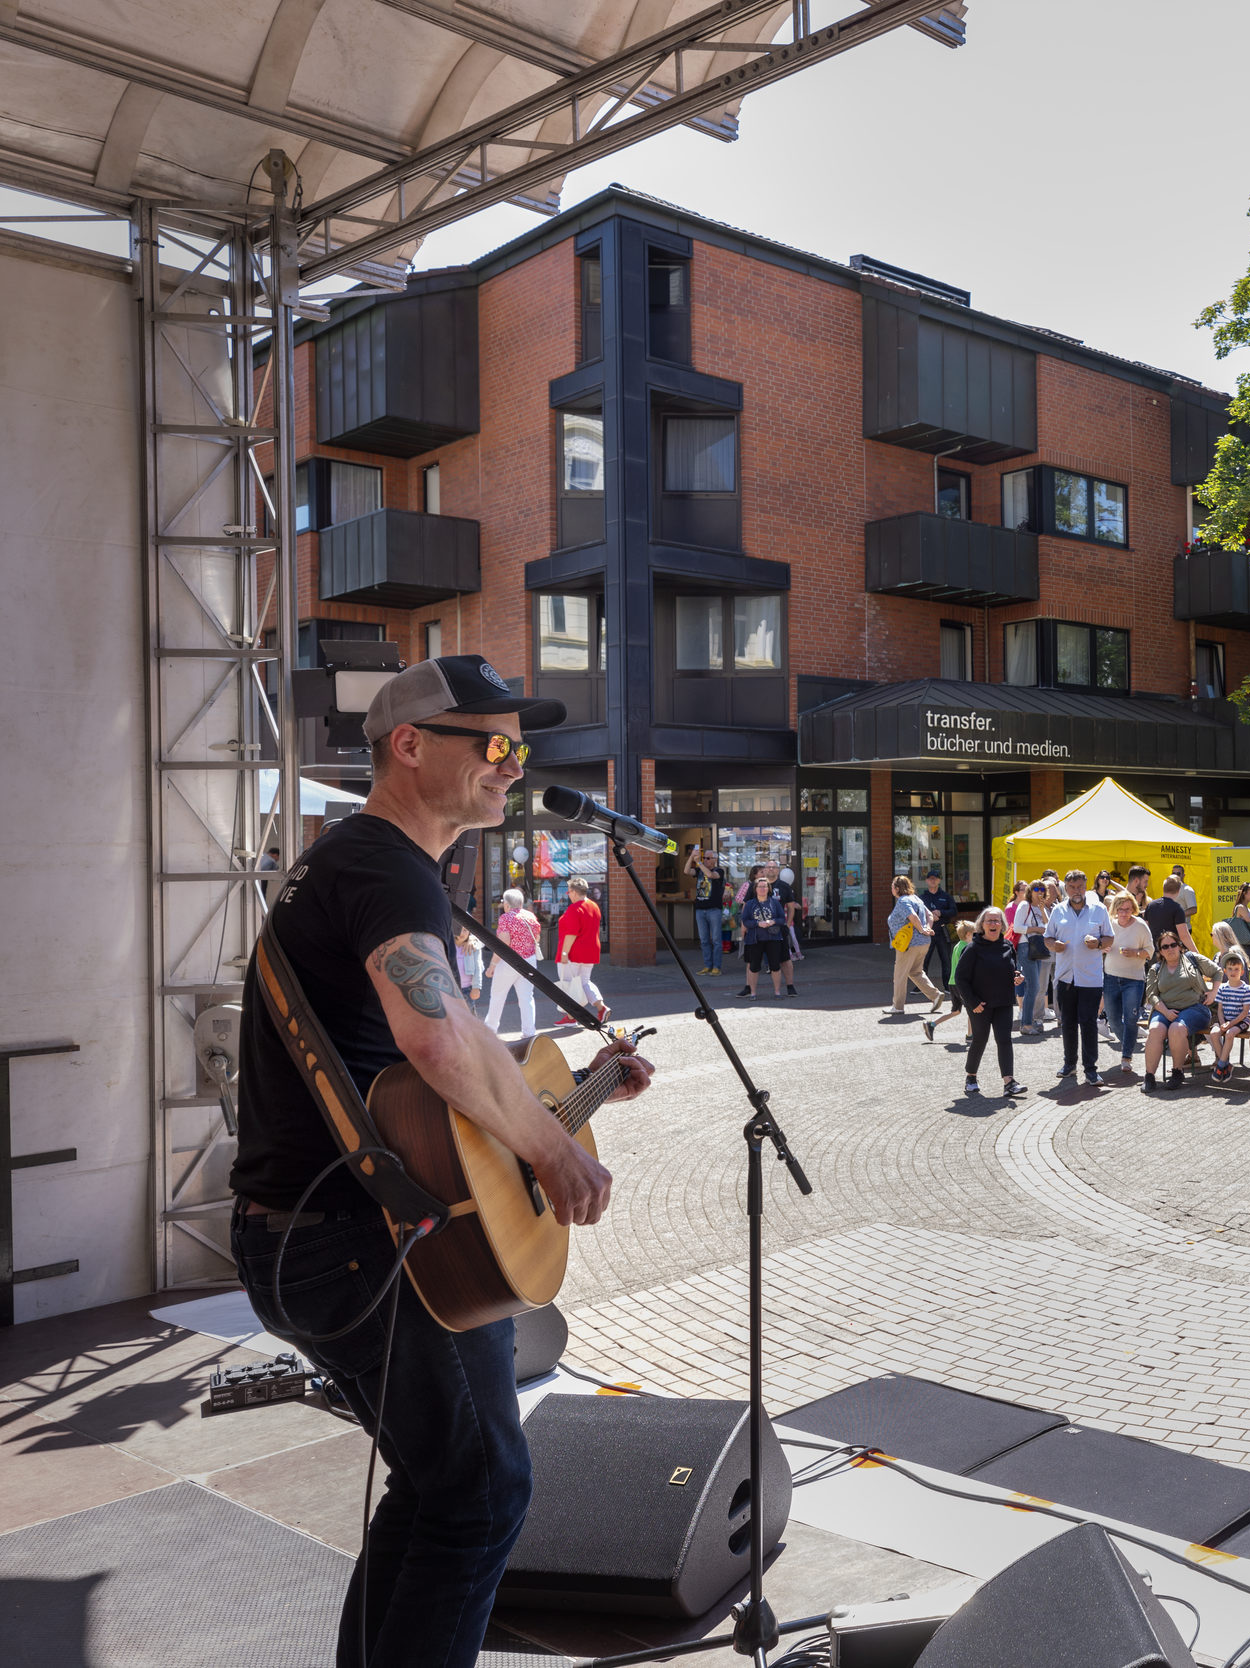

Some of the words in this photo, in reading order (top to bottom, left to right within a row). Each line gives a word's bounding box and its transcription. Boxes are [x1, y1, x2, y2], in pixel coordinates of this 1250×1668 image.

[926, 710, 996, 731] transfer.
[927, 732, 980, 752] bücher
[984, 737, 1012, 754] und
[1016, 739, 1071, 758] medien.
[1160, 845, 1192, 854] AMNESTY
[1216, 856, 1233, 864] BITTE
[1216, 865, 1248, 873] EINTRETEN
[1217, 874, 1229, 883] FÜR
[1230, 875, 1241, 883] DIE
